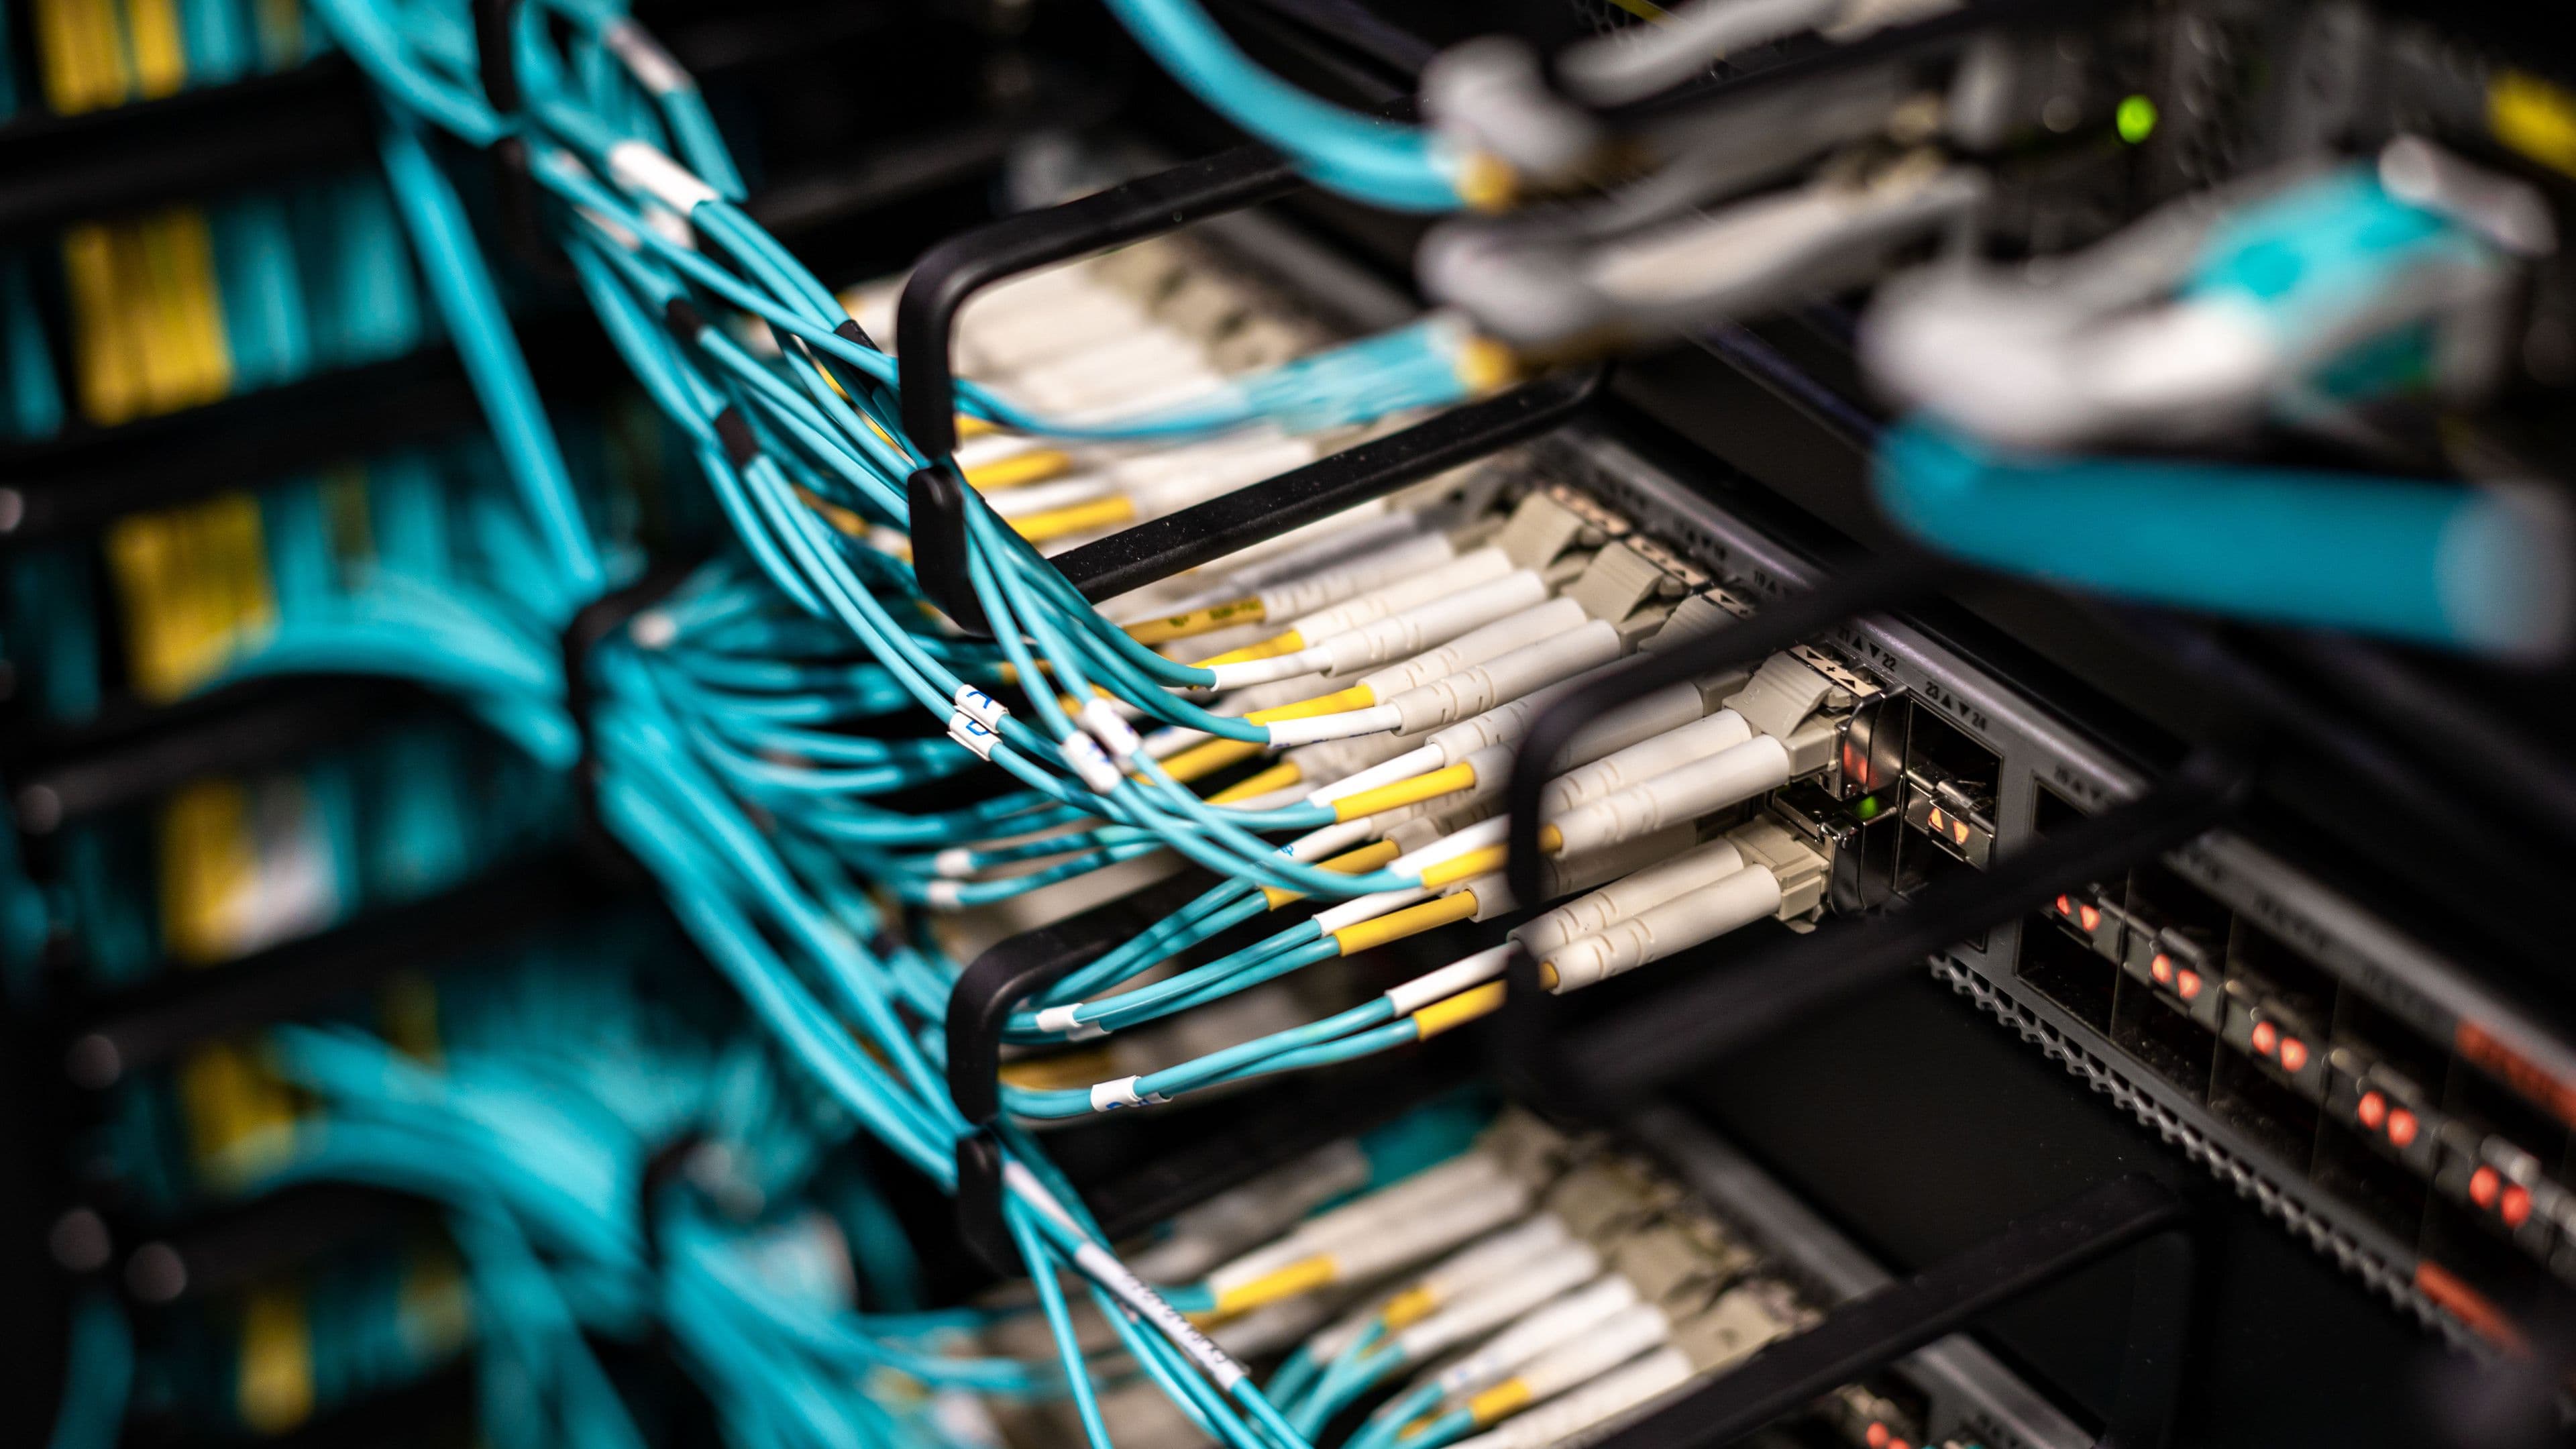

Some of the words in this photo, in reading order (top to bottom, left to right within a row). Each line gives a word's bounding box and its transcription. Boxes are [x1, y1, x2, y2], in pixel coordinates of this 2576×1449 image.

[1882, 652, 1897, 672] 22
[1924, 680, 1939, 700] 23
[1971, 708, 1987, 731] 24
